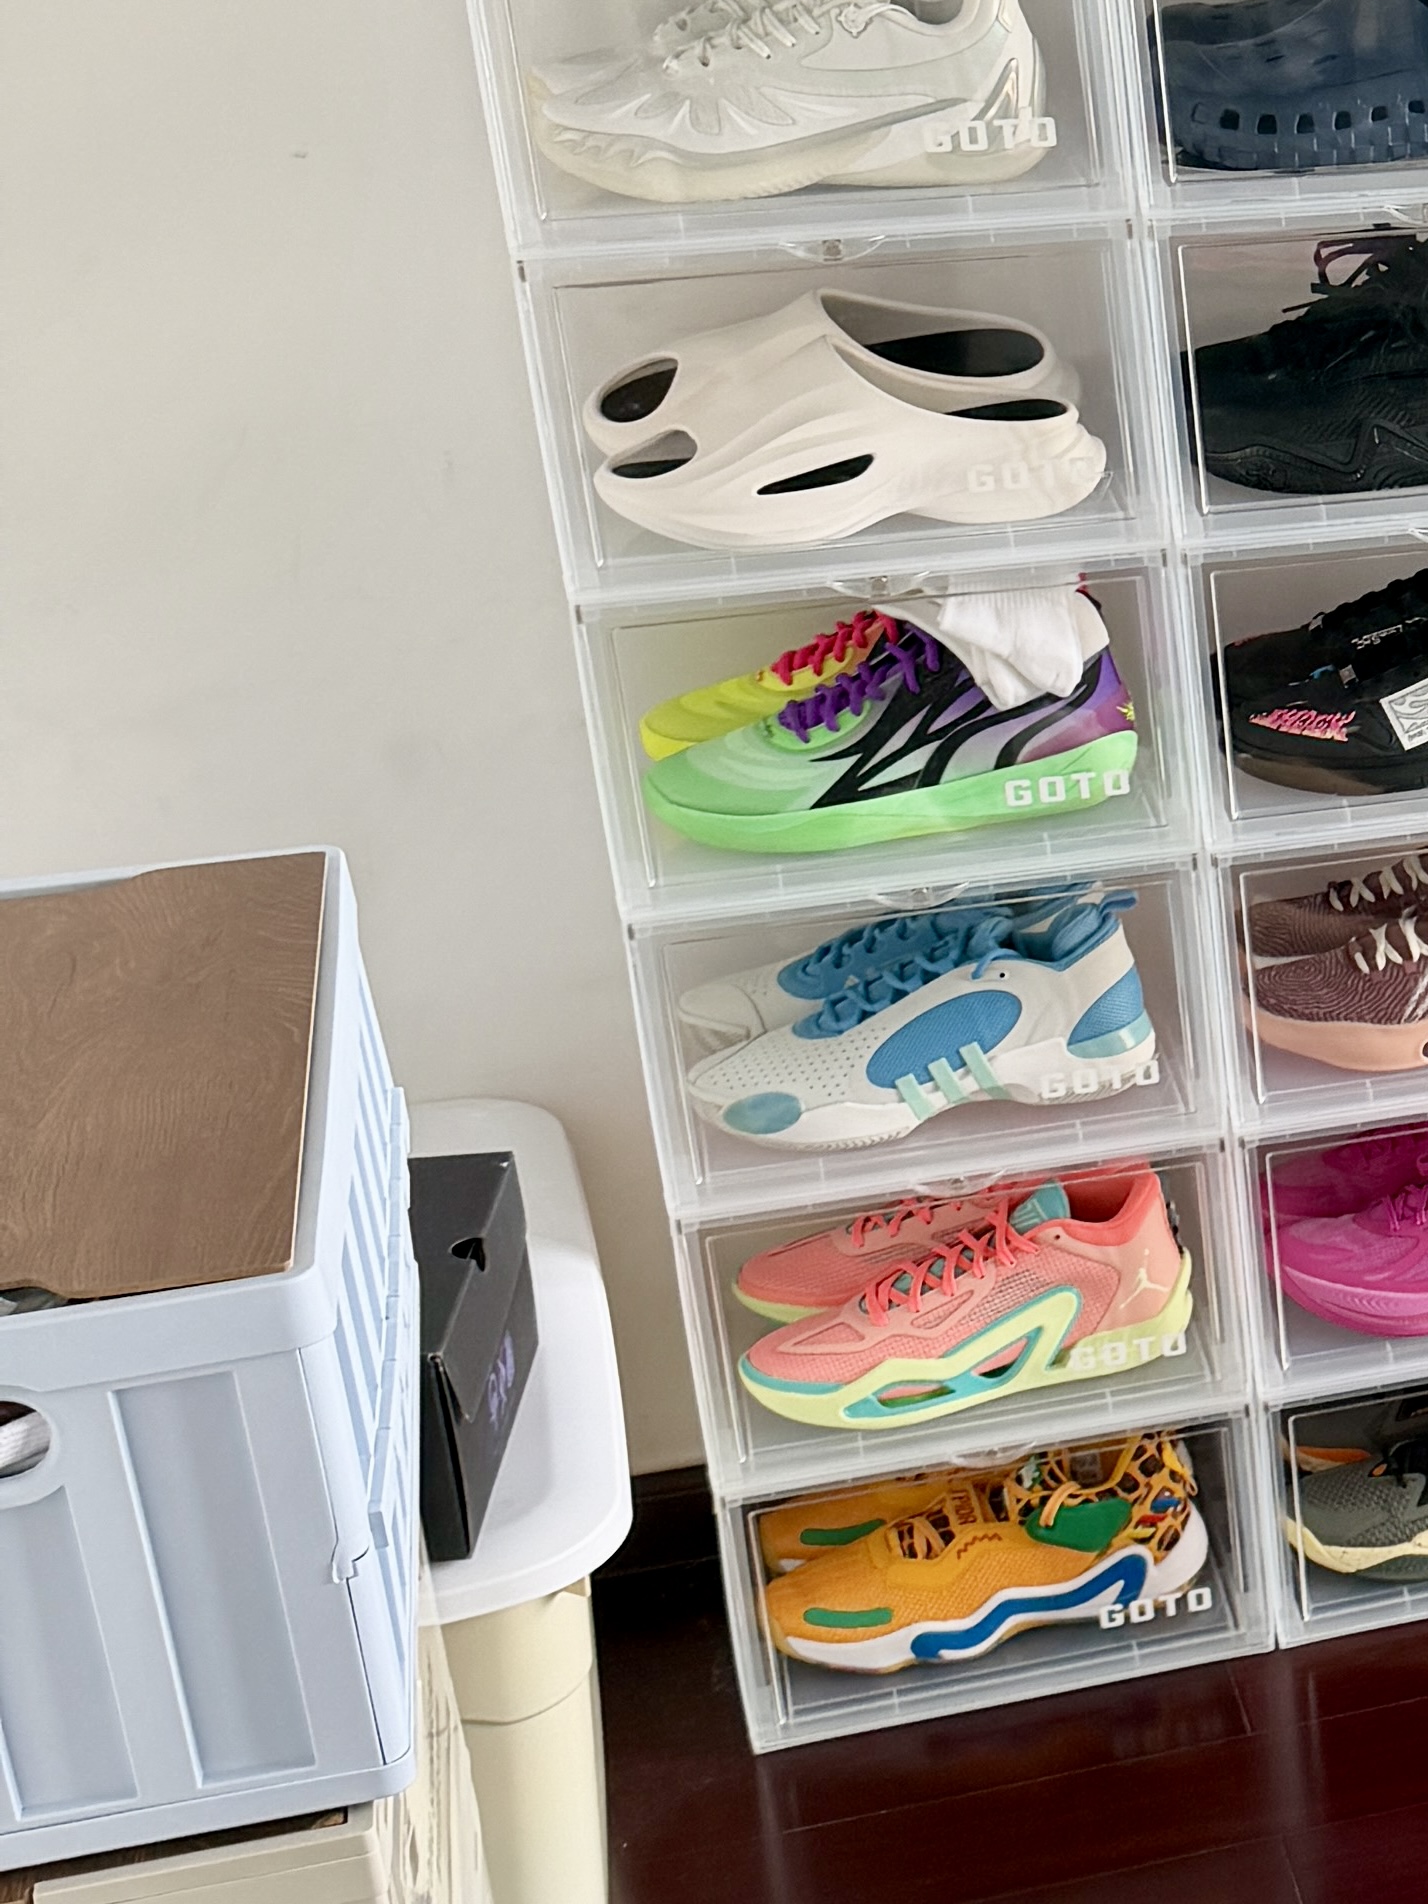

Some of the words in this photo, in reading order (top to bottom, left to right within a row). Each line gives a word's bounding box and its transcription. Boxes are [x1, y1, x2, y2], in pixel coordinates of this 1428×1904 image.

[1004, 771, 1131, 807] GOTO
[1042, 1060, 1160, 1097] GOTO
[1069, 1333, 1187, 1370] GOTO
[1100, 1588, 1213, 1629] GOTO
